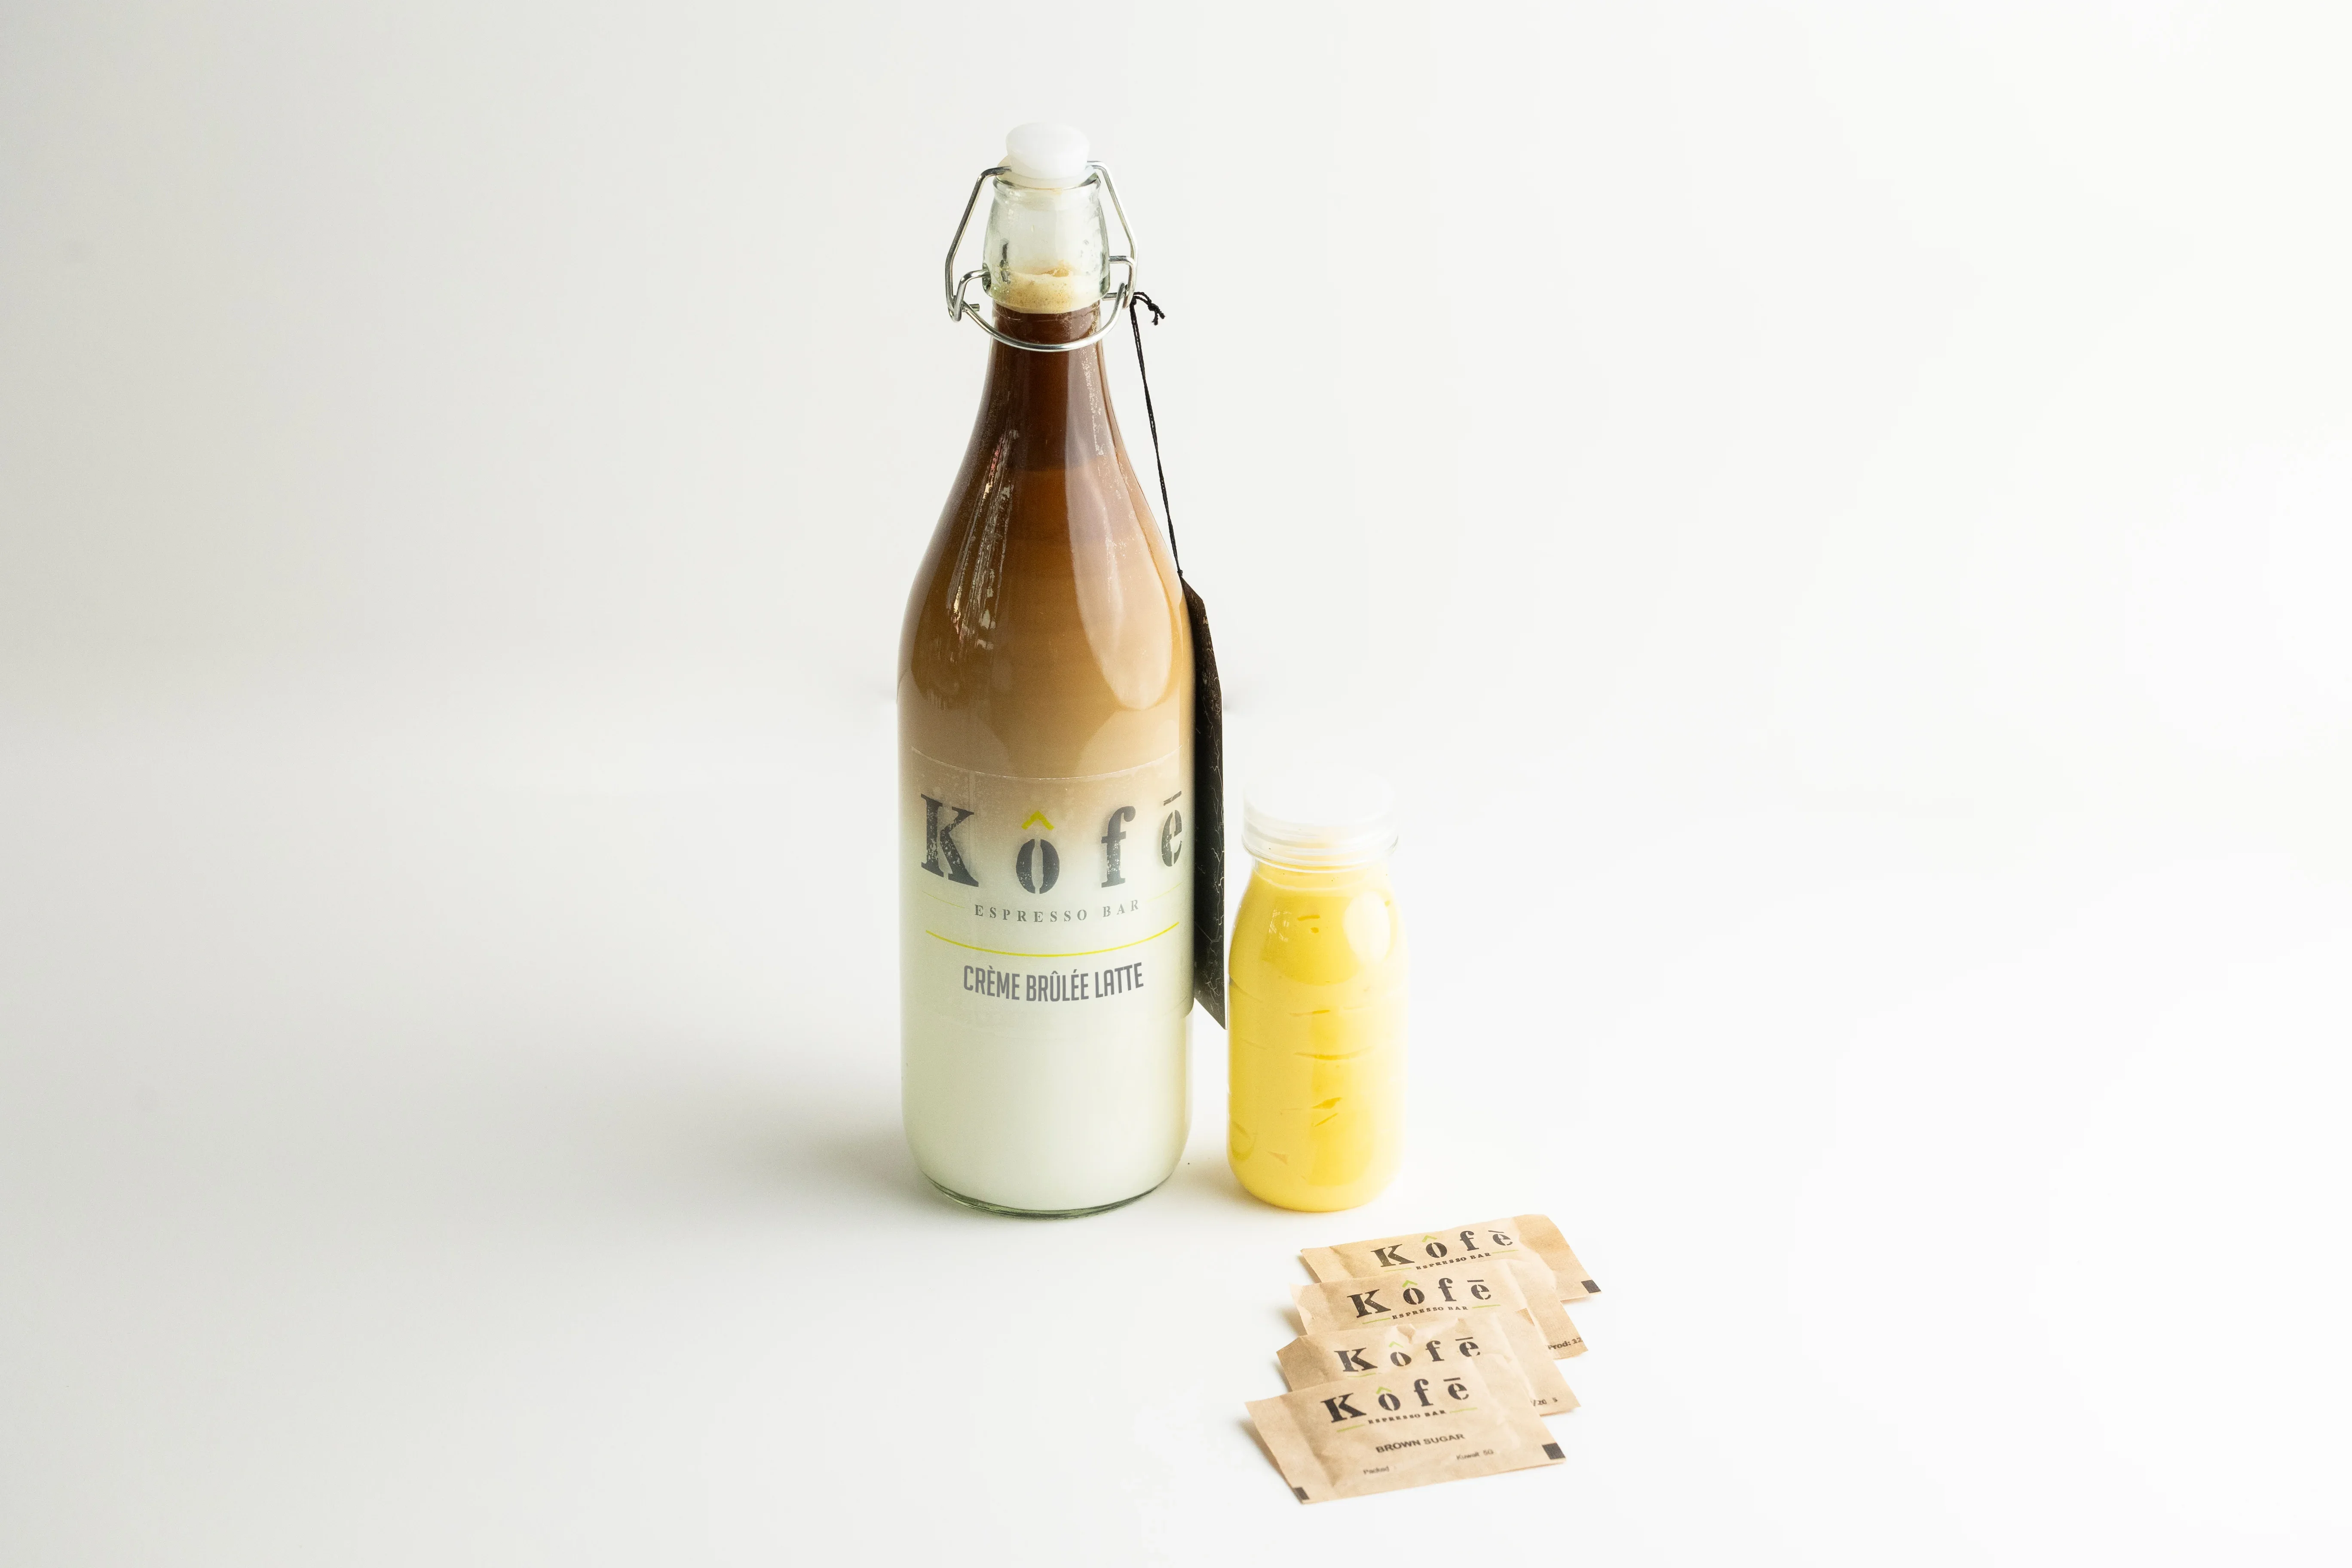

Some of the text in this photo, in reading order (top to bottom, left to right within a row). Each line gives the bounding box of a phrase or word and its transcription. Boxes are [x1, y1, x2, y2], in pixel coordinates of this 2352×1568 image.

[975, 899, 1139, 922] ESPRESSO BAR
[963, 962, 1144, 1002] CRÈME BRÛLÉE LATTE
[1415, 1256, 1467, 1270] ESPRESSO
[1392, 1306, 1444, 1320] ESPRESSO
[1368, 1413, 1421, 1424] ESPRESSO
[1375, 1433, 1465, 1454] BROWN SUGAR
